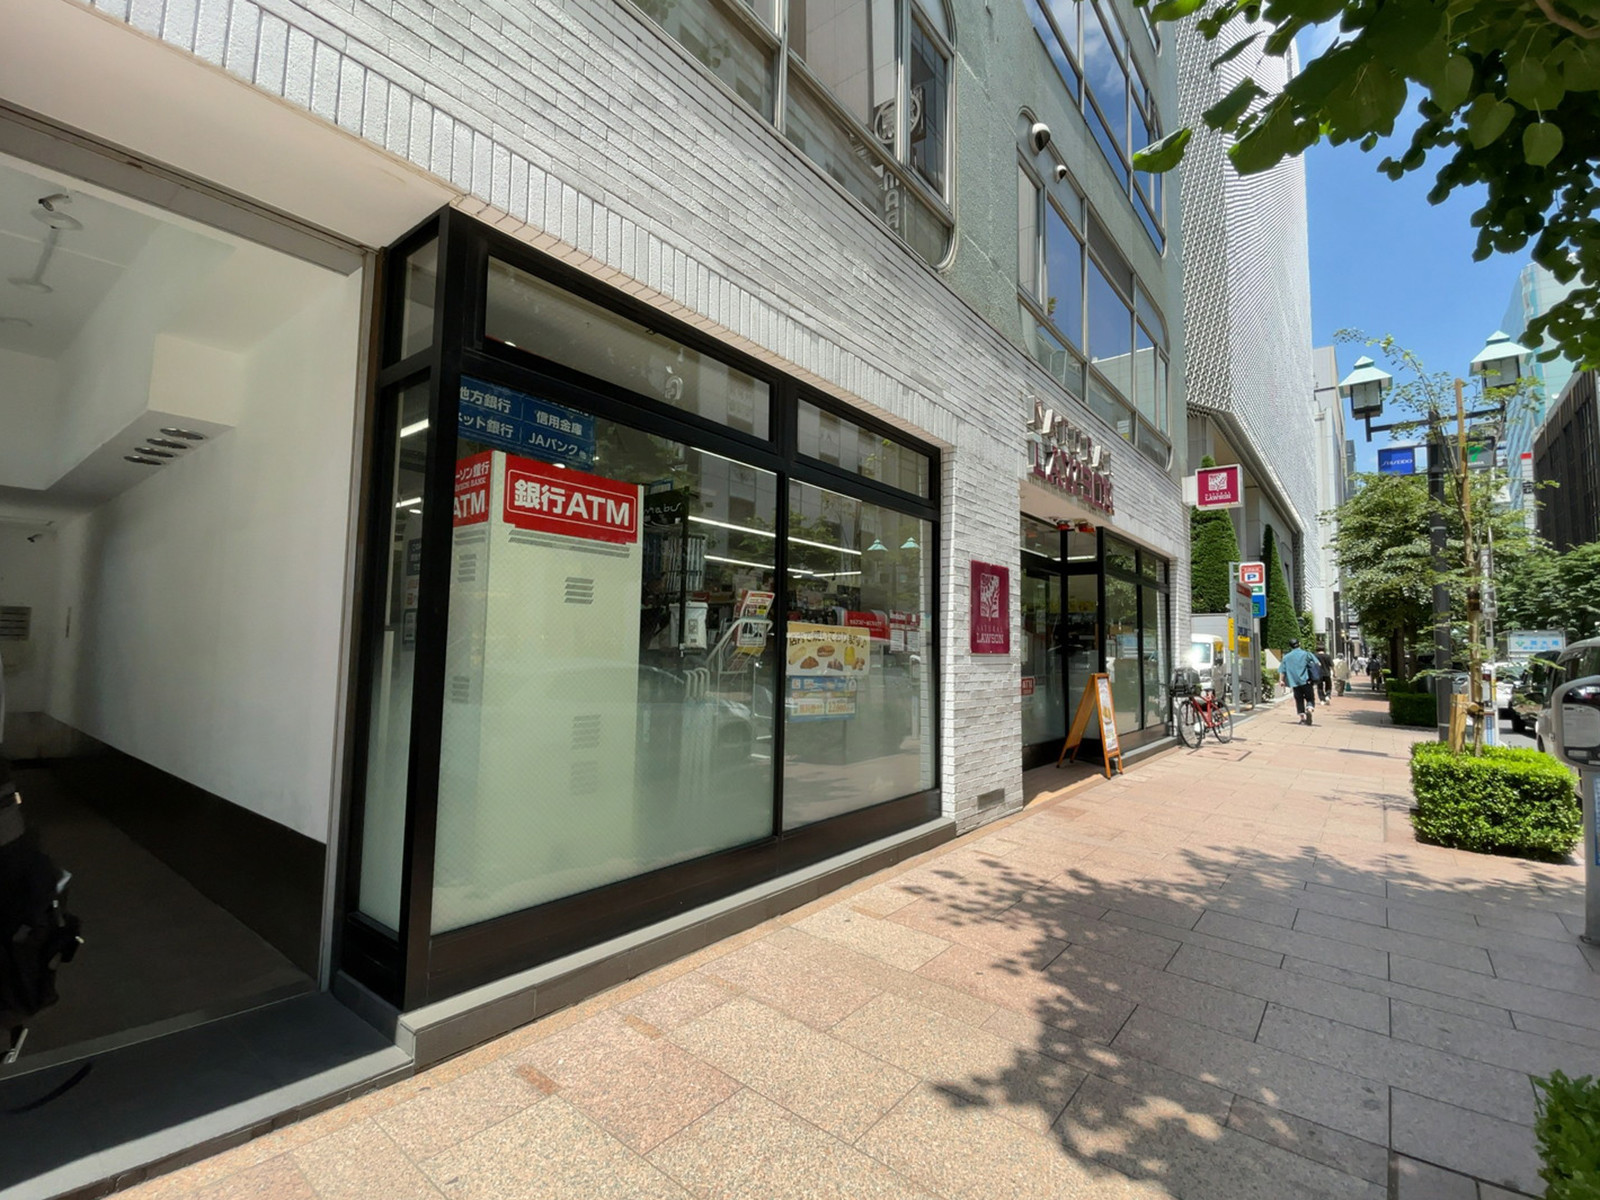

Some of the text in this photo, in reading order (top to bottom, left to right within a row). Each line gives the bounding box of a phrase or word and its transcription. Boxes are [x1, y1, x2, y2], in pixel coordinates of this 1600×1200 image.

[536, 411, 583, 436] 信用金庫
[453, 489, 486, 518] ATM
[513, 479, 630, 527] 銀行ATM
[1247, 573, 1257, 581] P
[976, 632, 1004, 645] LAWSON
